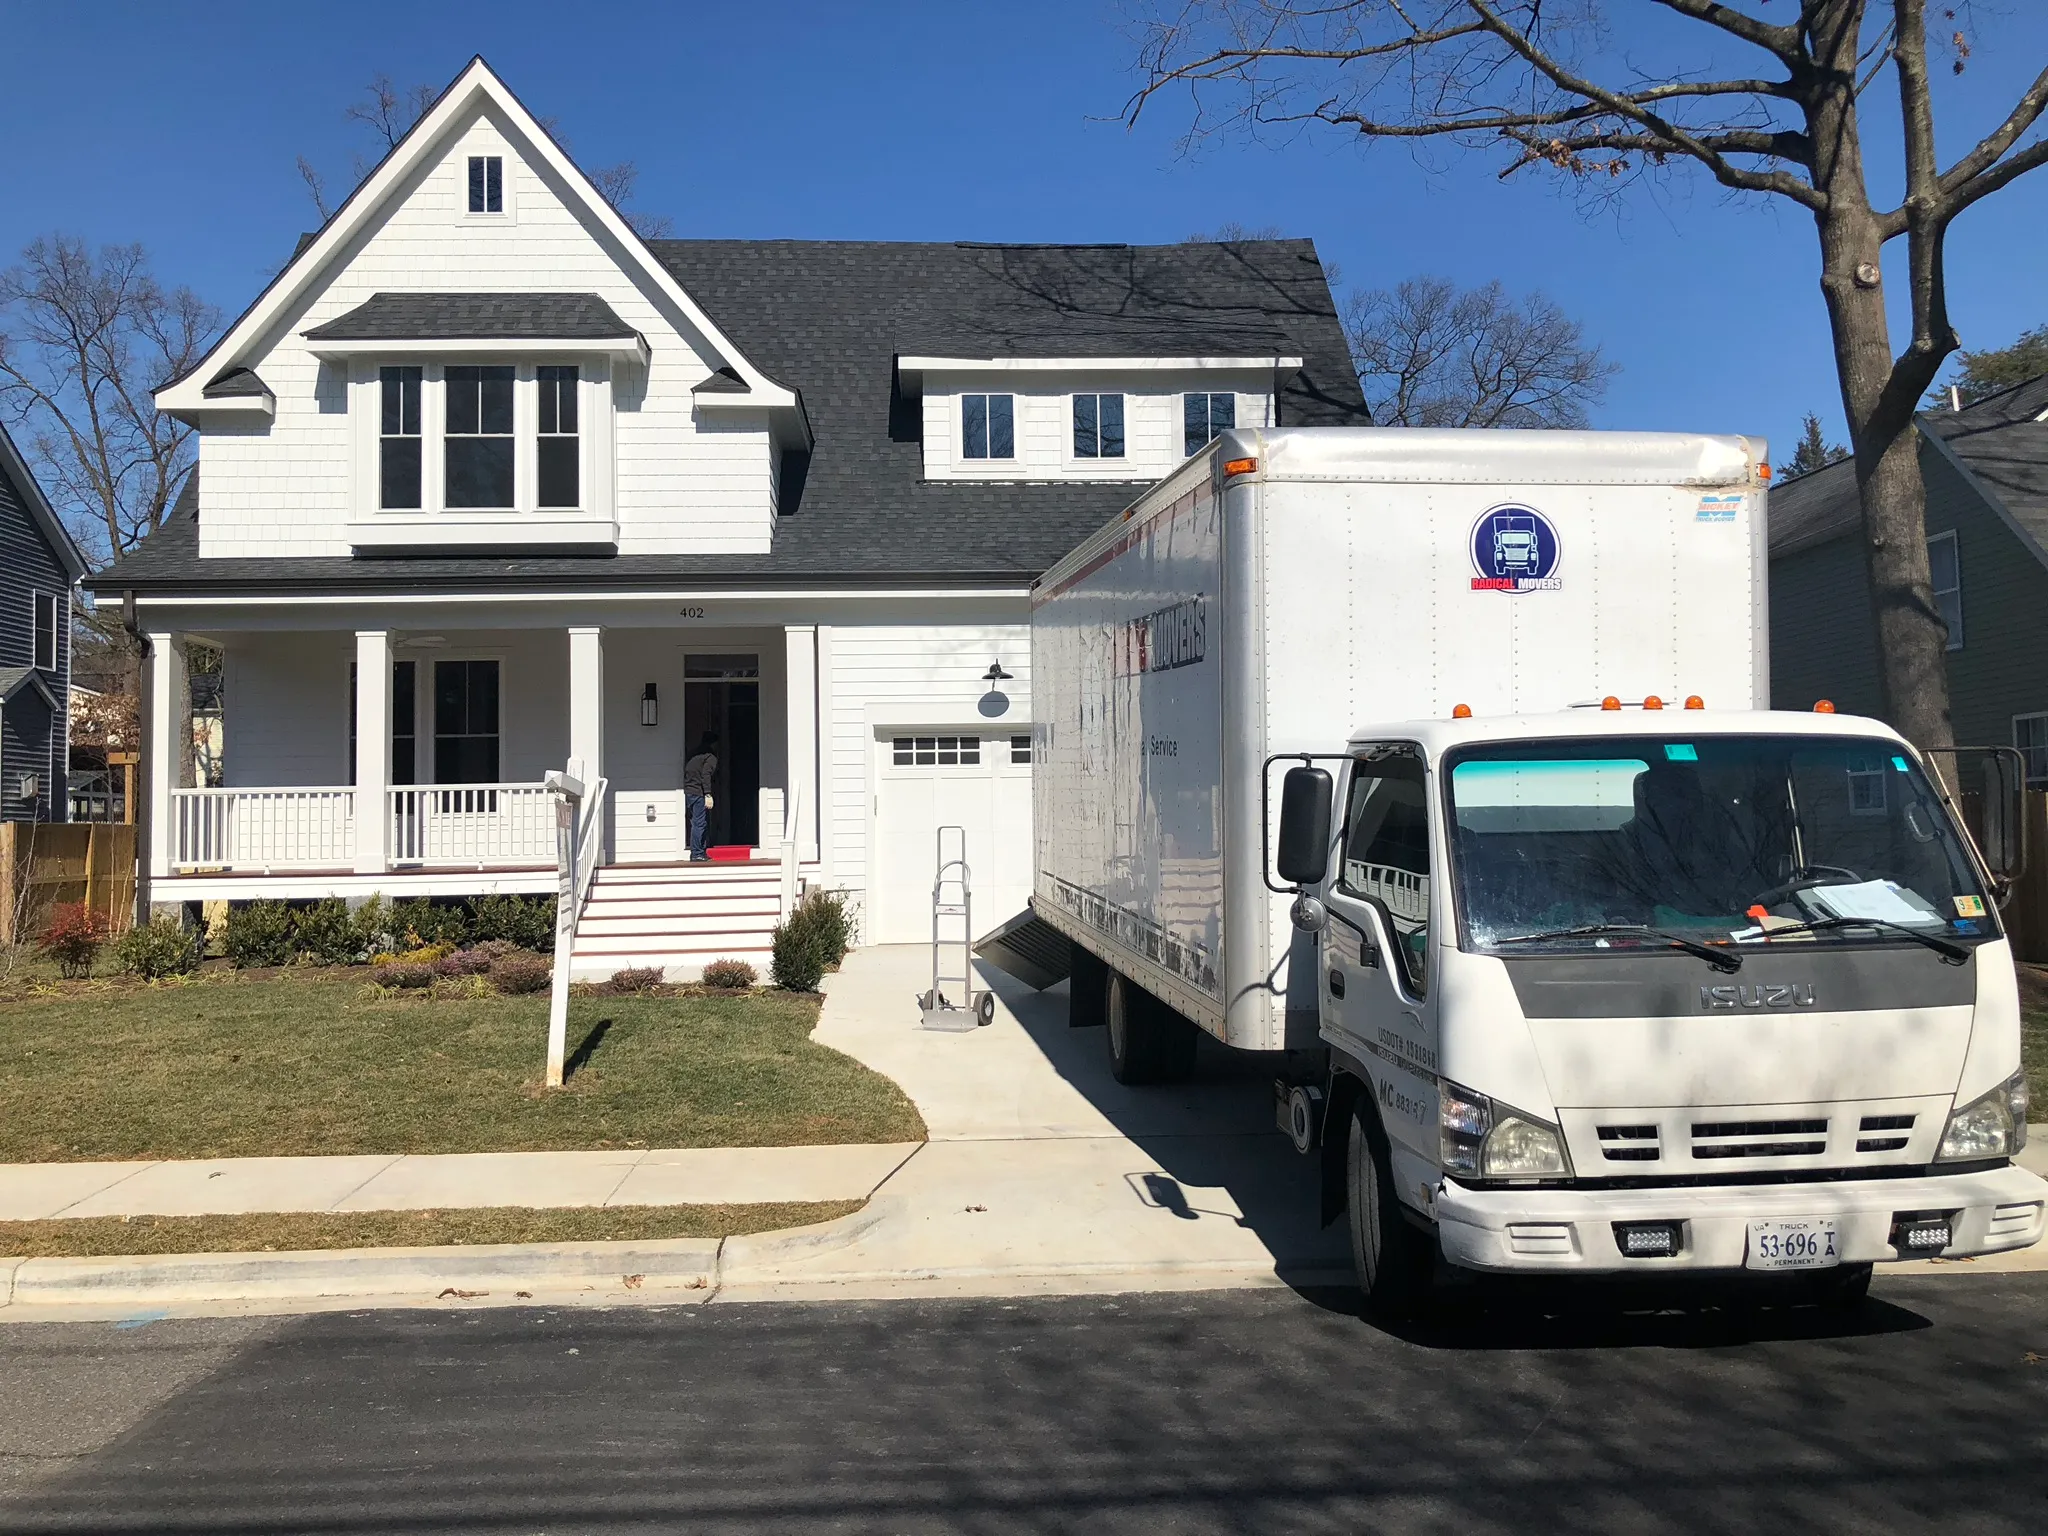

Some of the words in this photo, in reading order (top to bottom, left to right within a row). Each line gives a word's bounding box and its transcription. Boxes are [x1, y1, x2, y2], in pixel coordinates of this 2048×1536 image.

[1471, 577, 1516, 590] RADICAL
[1518, 577, 1562, 590] MOVERS
[680, 607, 704, 619] 402
[1150, 595, 1206, 672] MOVERS
[1150, 734, 1178, 757] Service
[1700, 983, 1817, 1010] ISUZU
[1377, 1046, 1399, 1065] ISUZU
[1379, 1078, 1395, 1108] MC
[1754, 1224, 1765, 1232] VA
[1779, 1222, 1809, 1230] TRUCK
[1826, 1221, 1833, 1229] P
[1760, 1232, 1818, 1258] 53-696
[1774, 1257, 1816, 1267] PERMANENT
